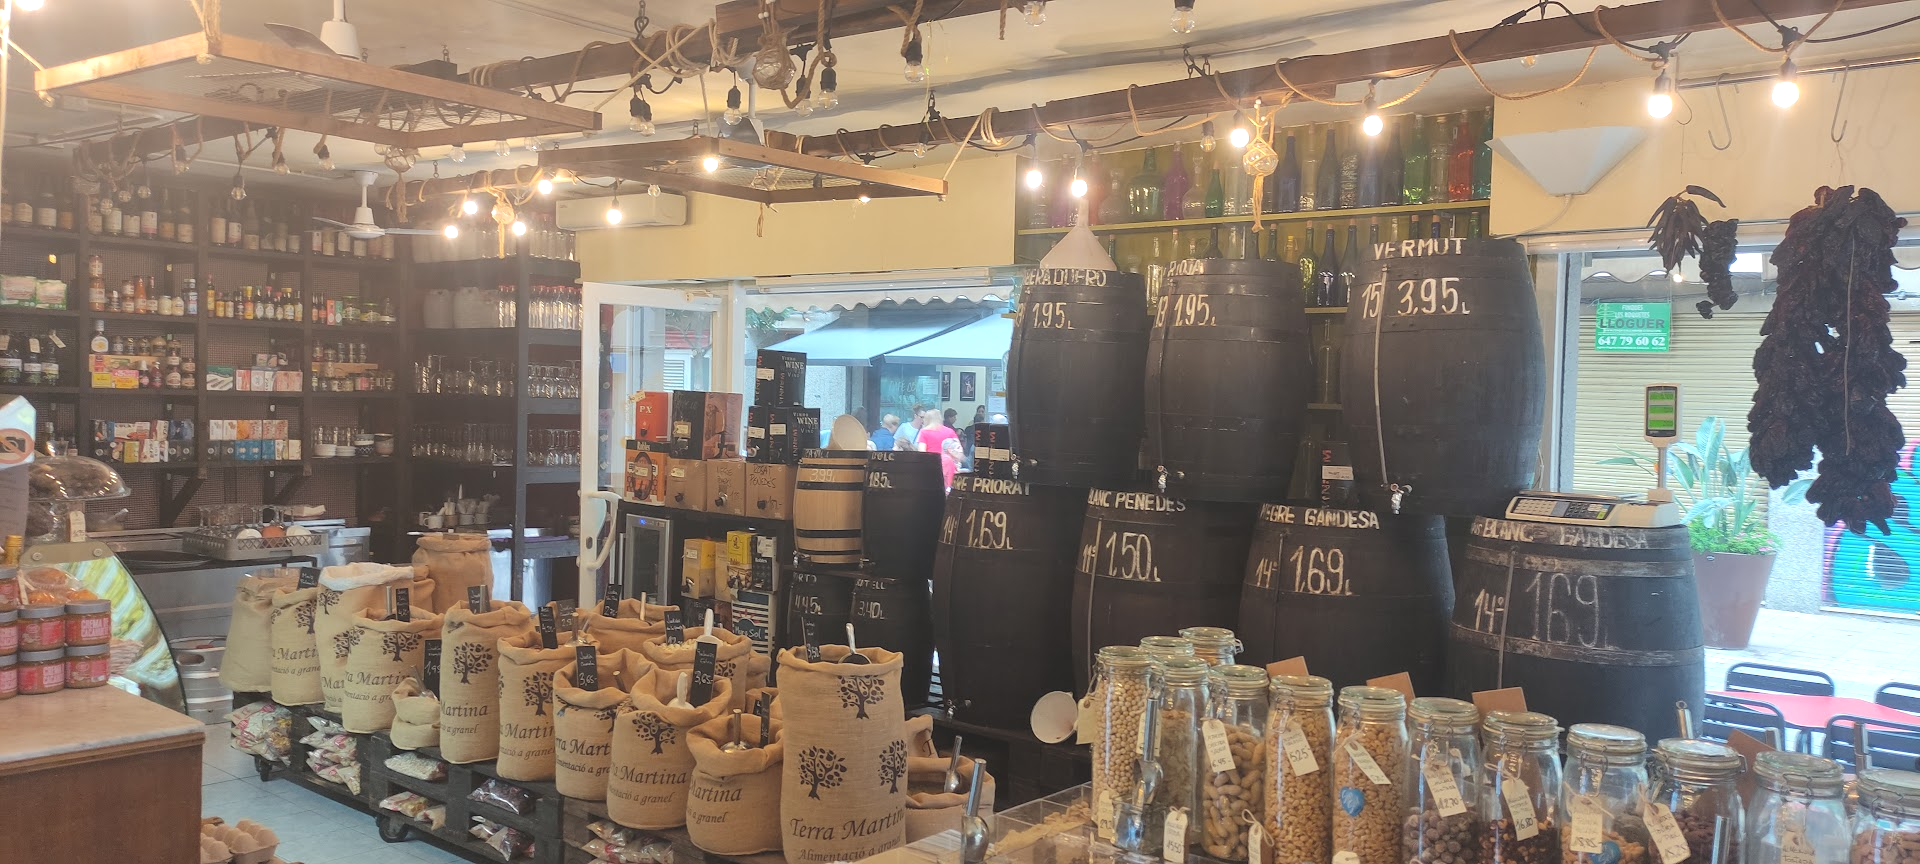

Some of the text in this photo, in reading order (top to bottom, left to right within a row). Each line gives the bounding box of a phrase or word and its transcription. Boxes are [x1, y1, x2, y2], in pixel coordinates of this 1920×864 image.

[1373, 236, 1468, 260] VERMUT
[1600, 318, 1665, 329] LLOGUER
[1597, 336, 1666, 347] 647 79 60 62
[785, 361, 805, 370] WINE
[639, 405, 653, 414] PX
[797, 417, 819, 425] WINE
[972, 477, 1030, 496] PRIORAT
[1304, 508, 1380, 529] GANDESA
[1482, 517, 1534, 543] BLANC
[1559, 526, 1649, 550] GANDESA
[451, 723, 480, 736] granel
[620, 765, 688, 785] Martina
[640, 792, 676, 806] granel
[697, 808, 729, 824] granel
[789, 818, 834, 840] Terra
[868, 847, 875, 857] a
